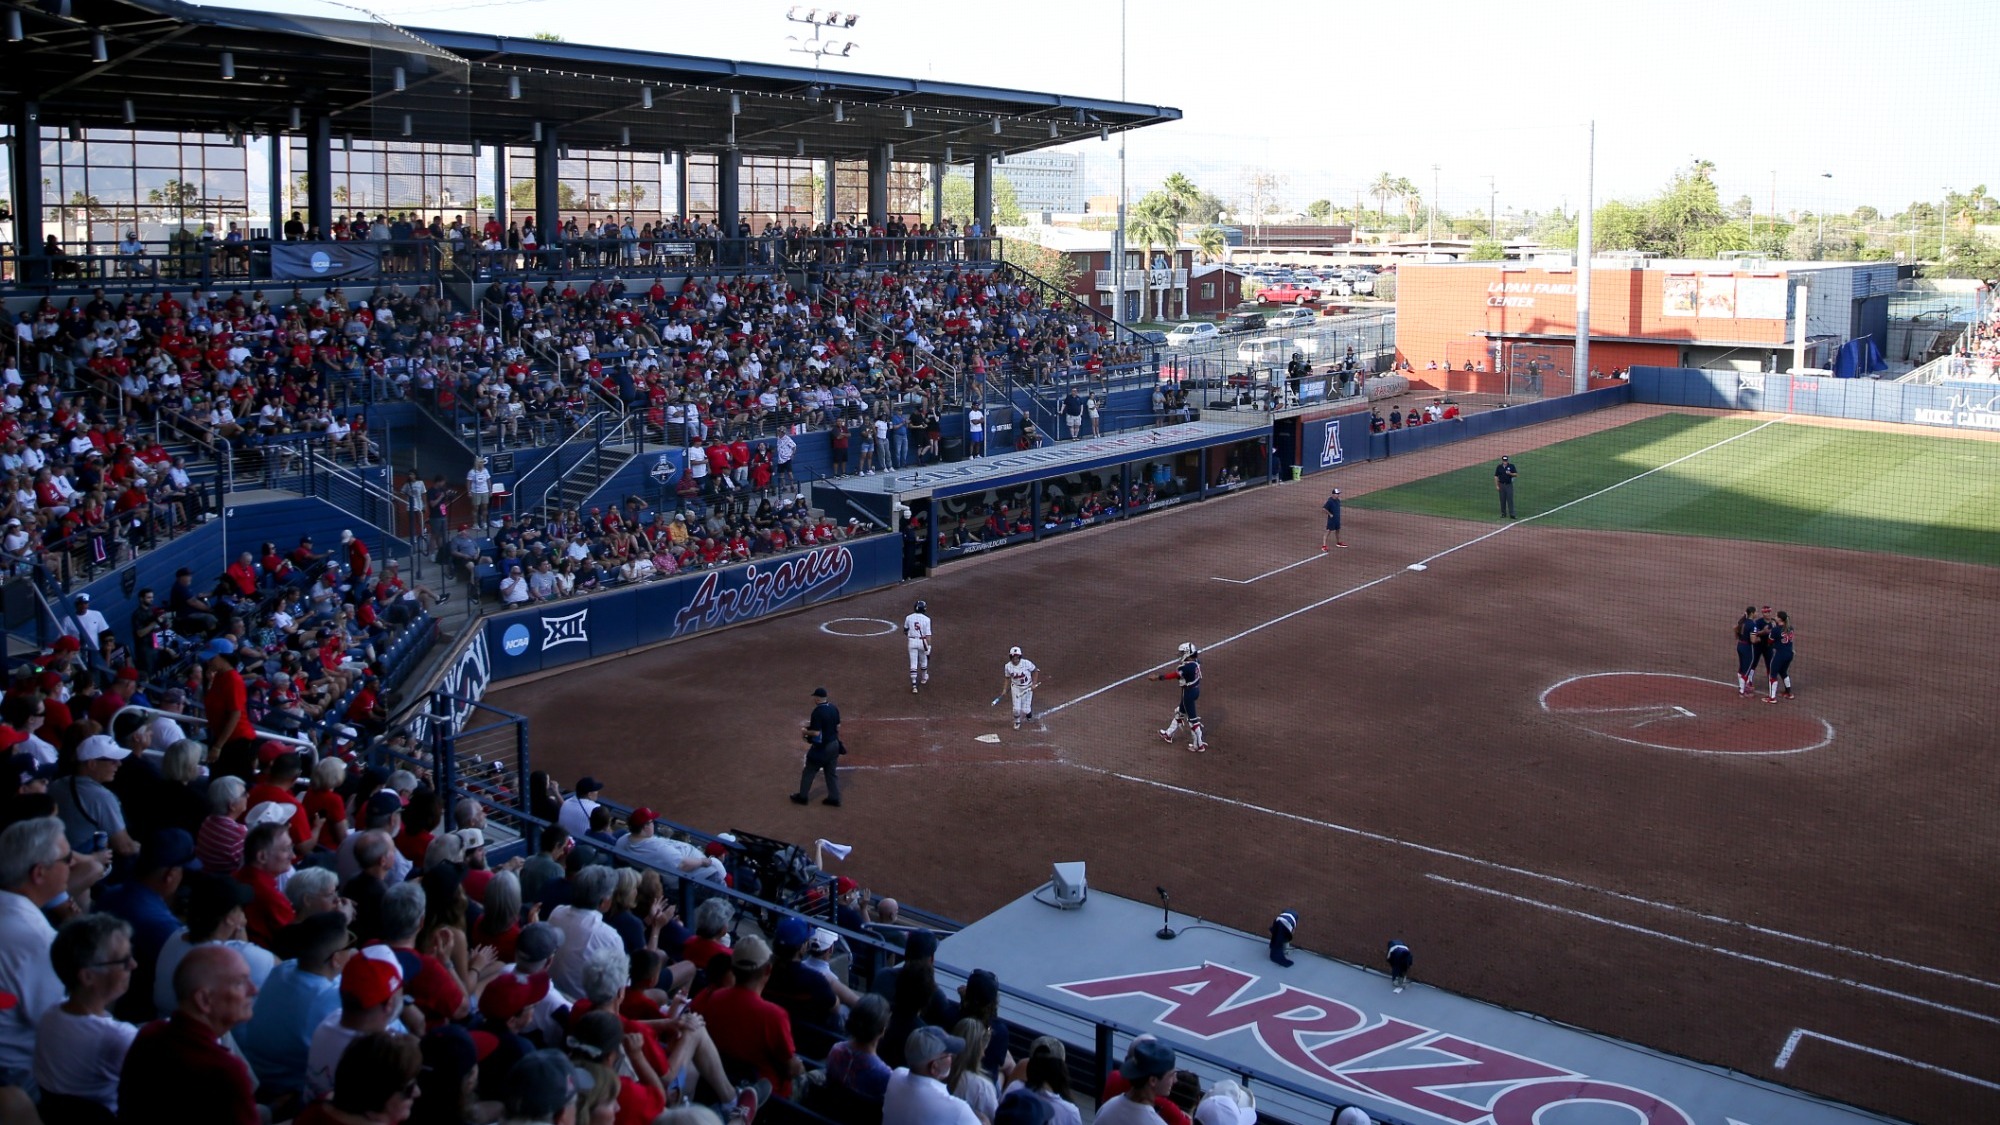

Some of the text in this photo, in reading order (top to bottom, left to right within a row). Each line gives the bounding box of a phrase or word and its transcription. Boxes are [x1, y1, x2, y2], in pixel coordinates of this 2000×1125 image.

[1487, 282, 1529, 293] LAPAN
[1486, 296, 1535, 308] CENTER
[1793, 381, 1818, 391] 200
[1914, 408, 1954, 425] MIKE
[1320, 420, 1343, 467] A
[380, 468, 387, 477] 5
[226, 508, 234, 517] 4
[672, 545, 854, 637] Arizona
[914, 622, 921, 631] 5
[505, 636, 529, 650] NCAA
[1047, 960, 1750, 1125] ARIZO
